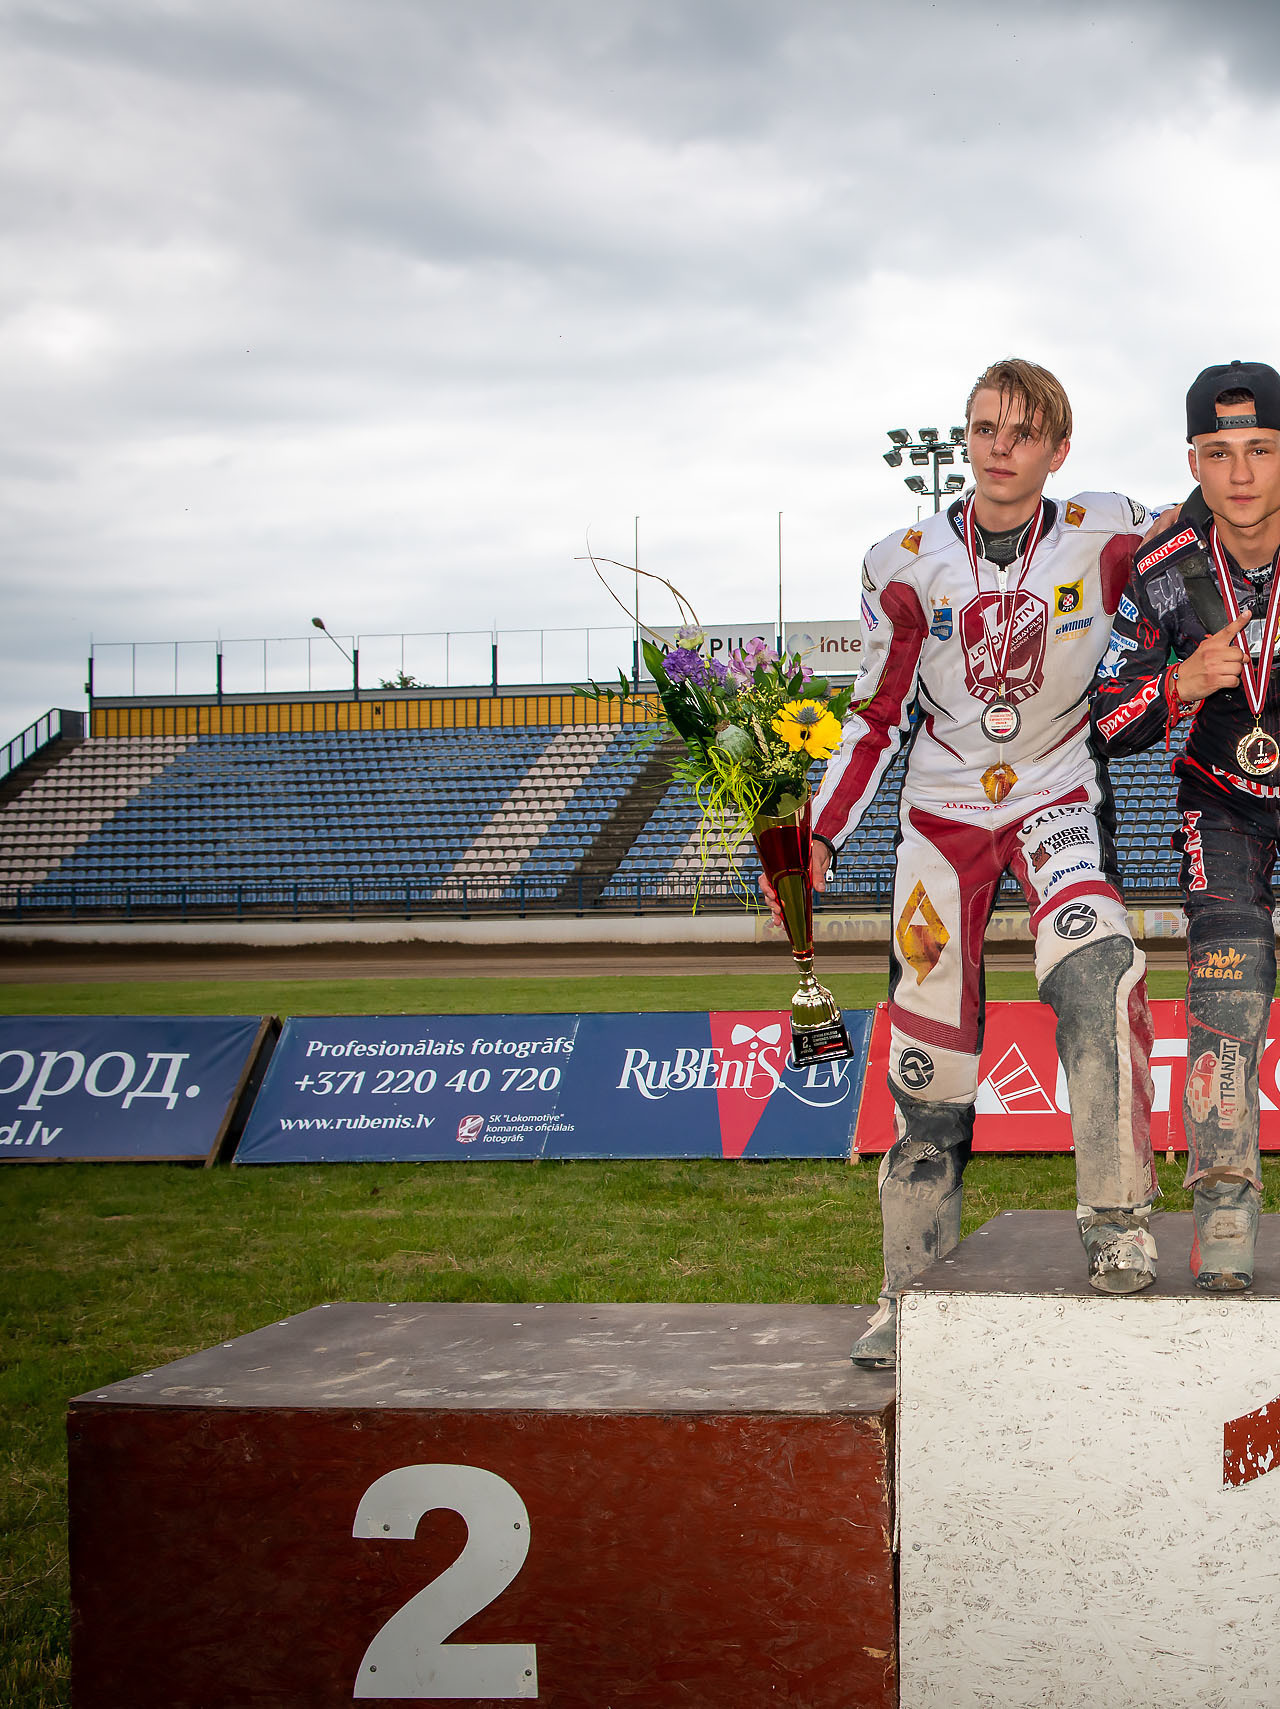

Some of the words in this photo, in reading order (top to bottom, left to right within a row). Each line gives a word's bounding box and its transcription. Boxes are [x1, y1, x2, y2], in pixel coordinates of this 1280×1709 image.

[1197, 967, 1243, 980] KEBAB
[306, 1040, 464, 1057] Profesionālais
[471, 1038, 575, 1059] fotogrāfs
[294, 1071, 366, 1095] +371
[372, 1070, 437, 1093] 220
[445, 1069, 490, 1093] 40
[500, 1067, 561, 1091] 720
[280, 1114, 435, 1130] www.rubenis.lv
[486, 1124, 541, 1133] komandas
[544, 1123, 575, 1132] oficiālais
[483, 1134, 524, 1143] fotogrāfs
[352, 1463, 538, 1698] 2
